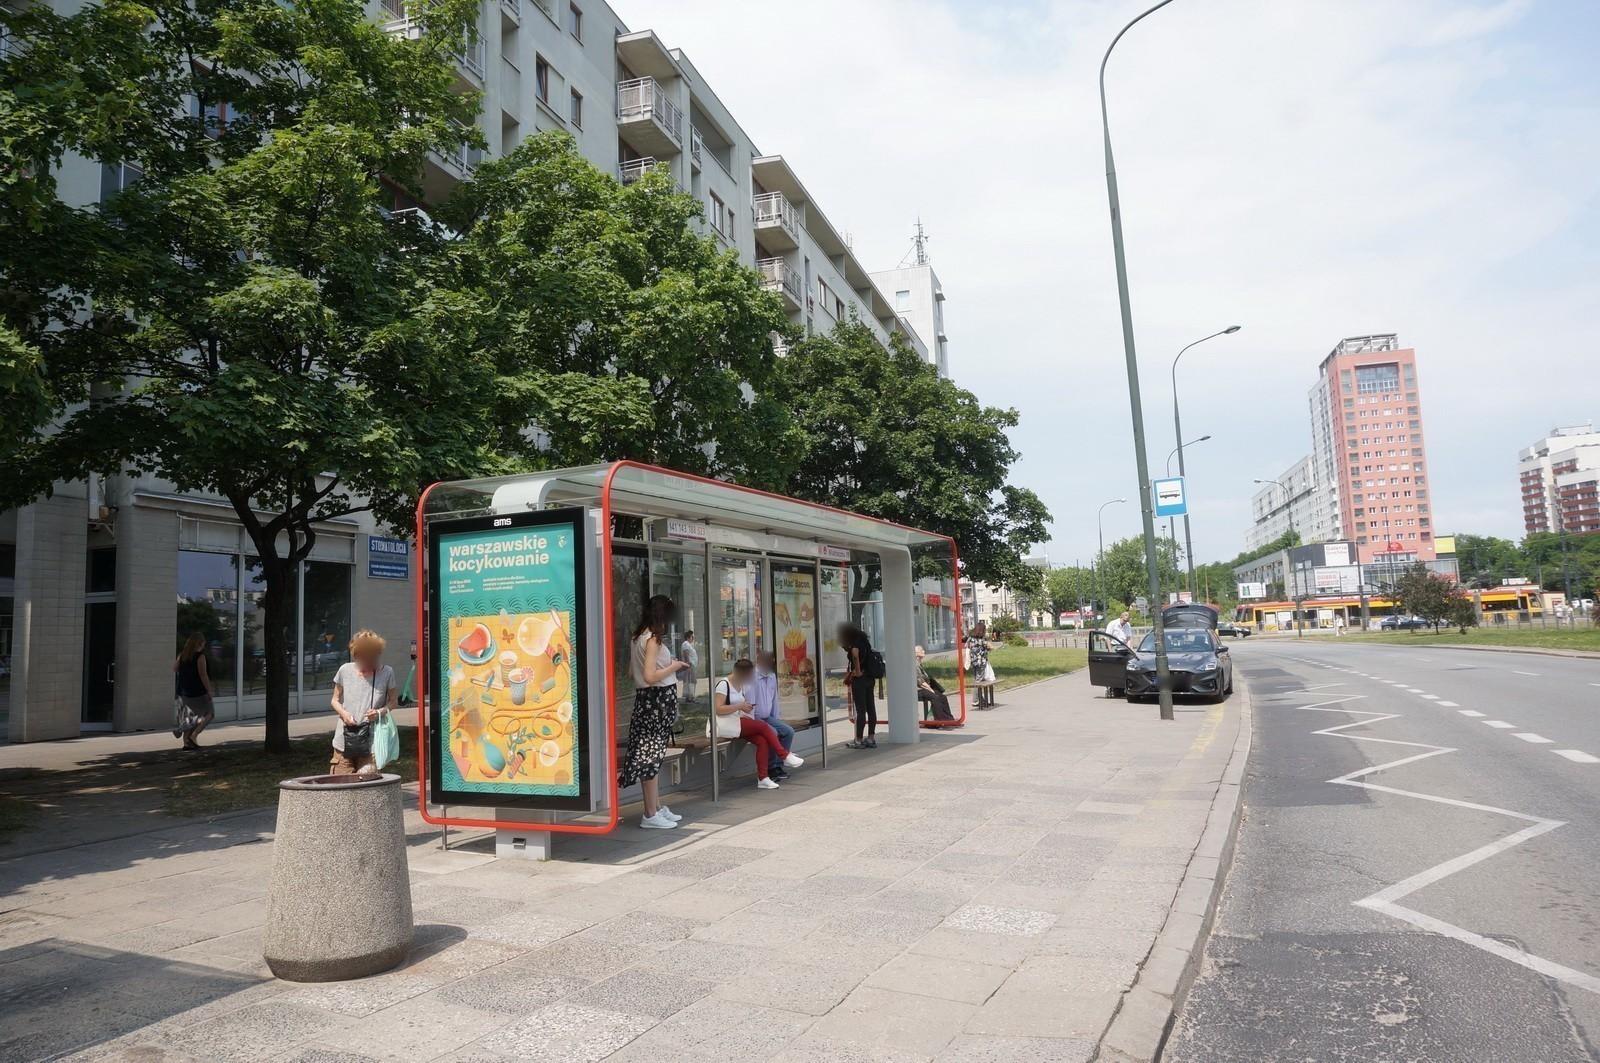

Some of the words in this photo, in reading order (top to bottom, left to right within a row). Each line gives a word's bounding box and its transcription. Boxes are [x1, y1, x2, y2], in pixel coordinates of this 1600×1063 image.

[493, 517, 512, 527] ams
[449, 535, 547, 557] warszawskie
[449, 550, 549, 574] kocykowanie
